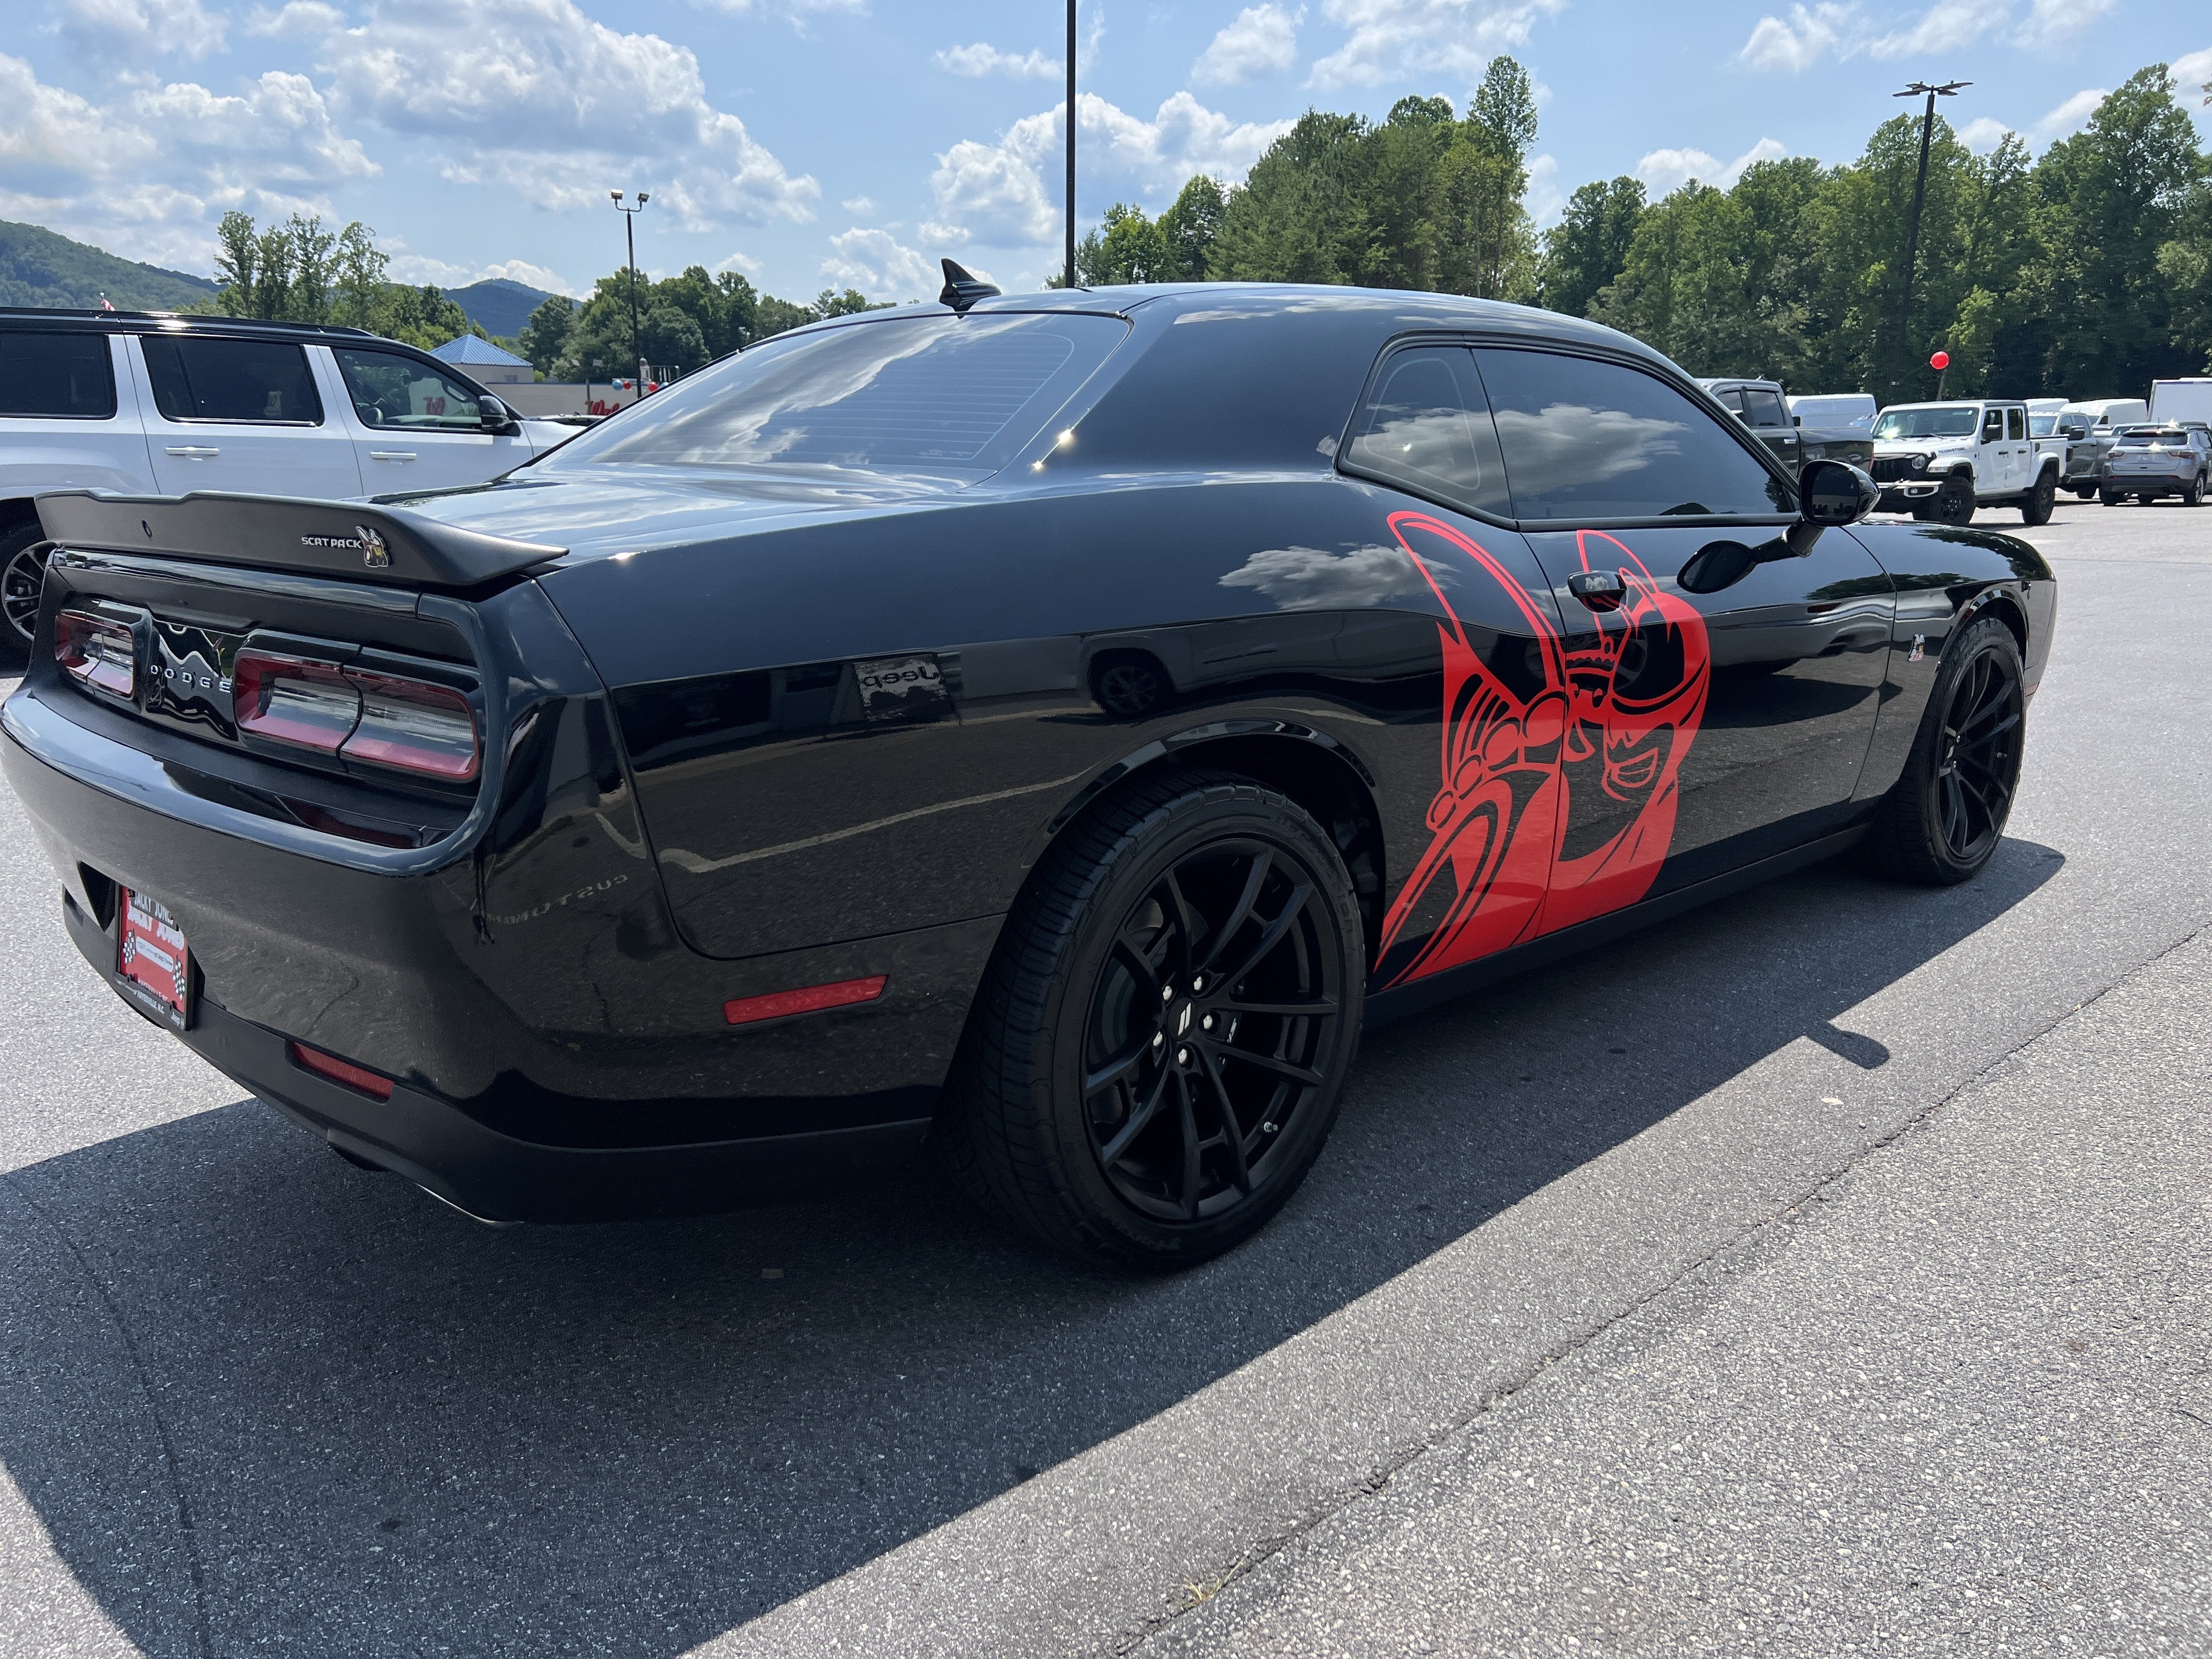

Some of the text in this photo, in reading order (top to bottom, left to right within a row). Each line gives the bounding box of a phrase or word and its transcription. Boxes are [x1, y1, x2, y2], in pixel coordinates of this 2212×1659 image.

[302, 537, 363, 549] SCAT PACK
[151, 664, 232, 693] DODGE
[134, 890, 151, 913] JACKY
